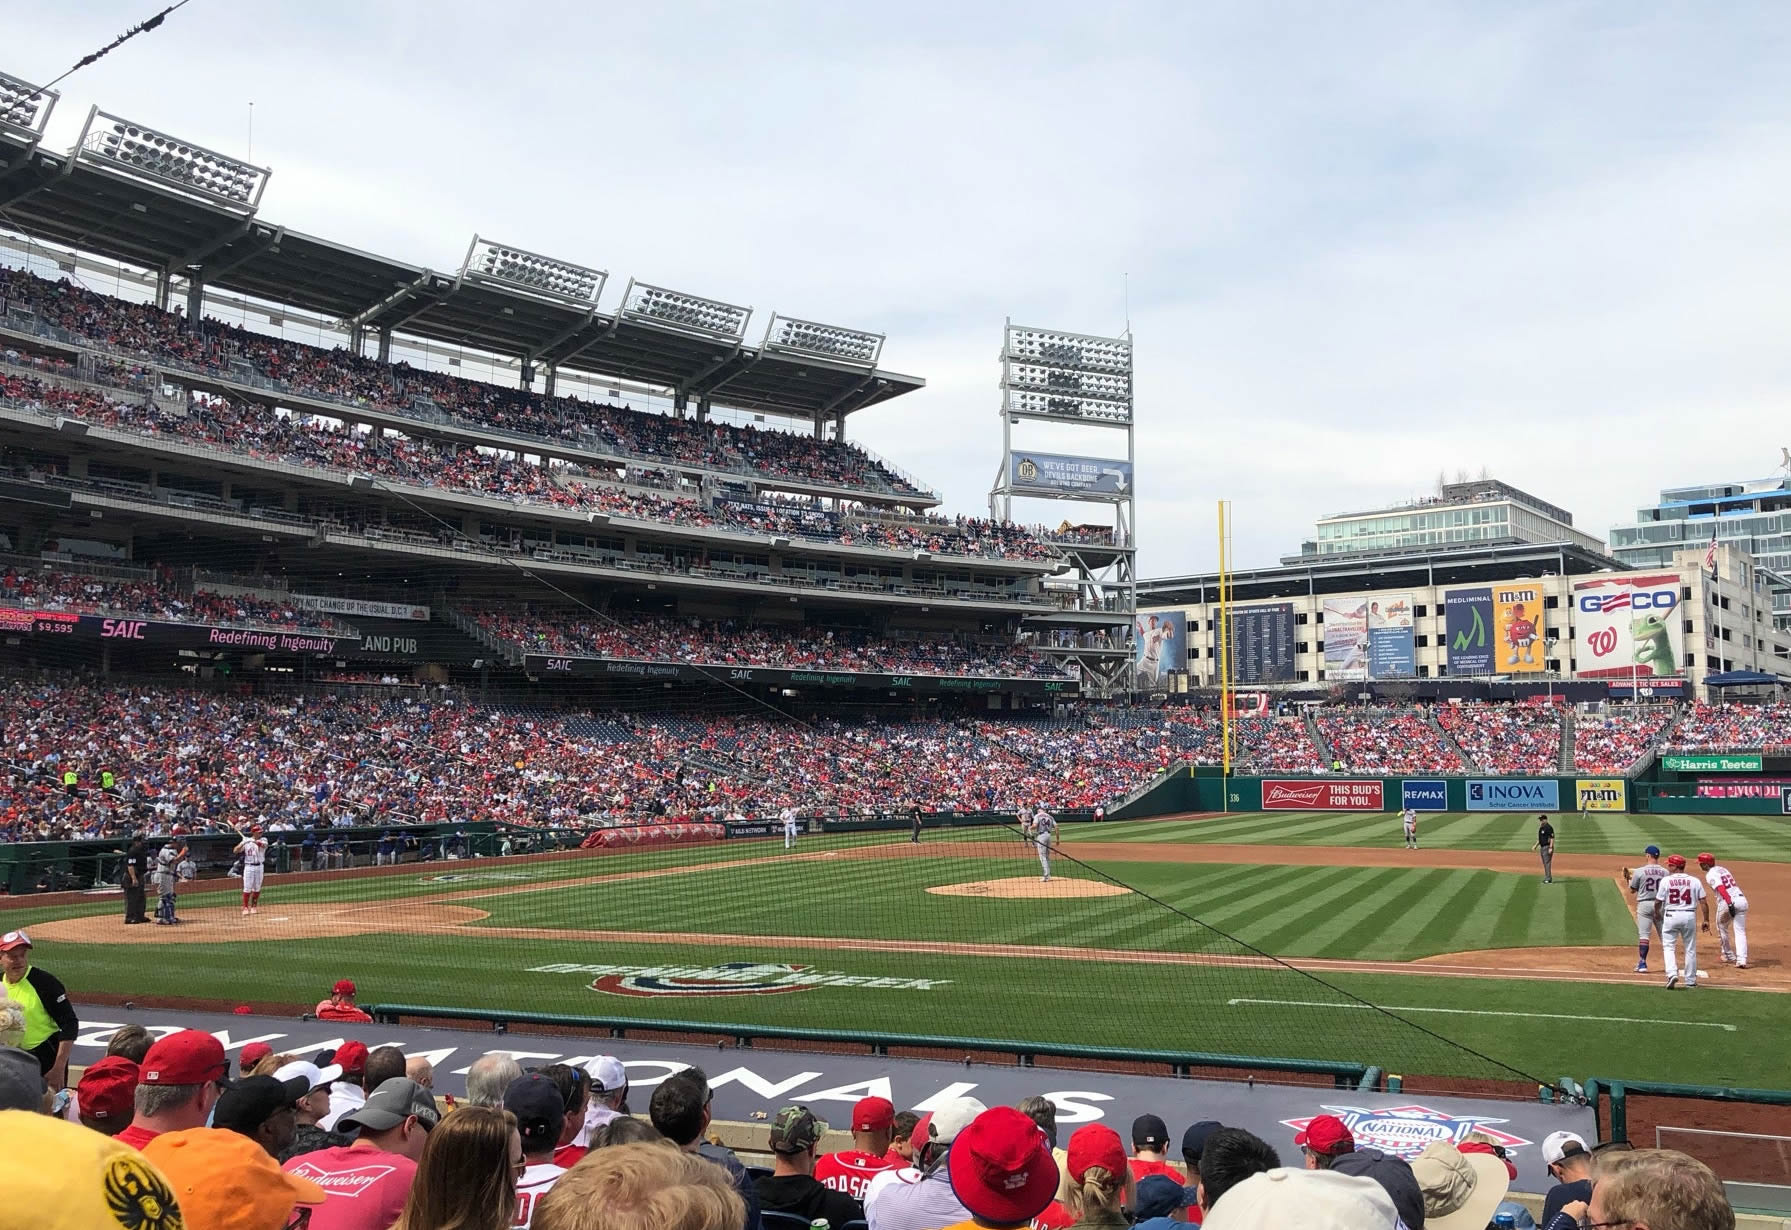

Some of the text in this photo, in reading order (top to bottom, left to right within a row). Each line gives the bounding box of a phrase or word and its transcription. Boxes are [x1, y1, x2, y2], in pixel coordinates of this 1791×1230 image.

[1066, 462, 1079, 471] GOT
[1045, 472, 1098, 482] DEVILS BACKBONE
[320, 600, 345, 610] CHANGE
[346, 602, 355, 610] UP
[356, 602, 368, 611] THE
[1447, 596, 1491, 604] MEDLIMINAL
[1580, 591, 1676, 613] GECO
[38, 622, 73, 633] $9,595
[101, 619, 335, 653] SAIC Redefining Ingenuity
[361, 635, 417, 654] AND PUB
[546, 659, 1064, 691] SAIC Redefining Ingenuity SAIC Redefining Ingenuity SAIC Redefining Ingenuity SAIC
[1680, 759, 1759, 769] Harris Teeter
[1272, 785, 1381, 800] Budweiser THIS BUD'S
[1404, 790, 1444, 799] RE/MAX
[1489, 786, 1544, 799] INOVA
[1329, 796, 1372, 806] FOR YOU.
[1669, 888, 1692, 904] 24
[1363, 1123, 1445, 1139] NATIONAL
